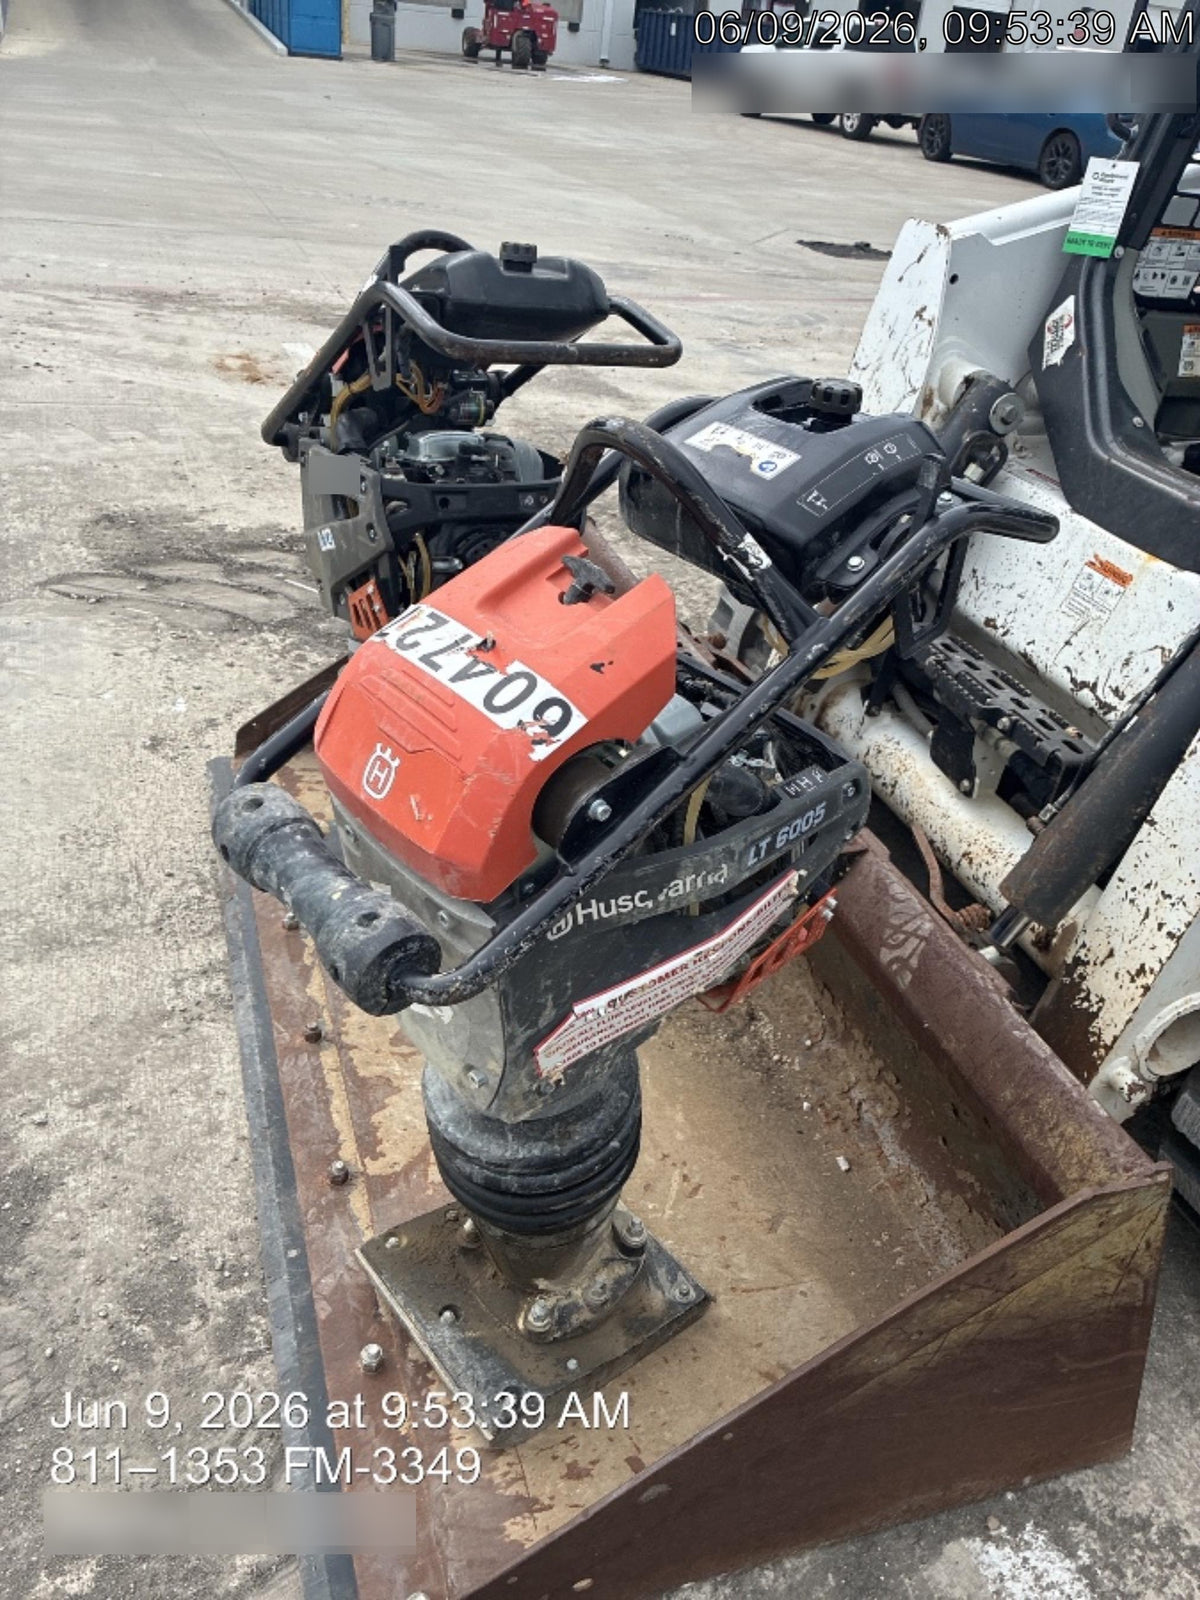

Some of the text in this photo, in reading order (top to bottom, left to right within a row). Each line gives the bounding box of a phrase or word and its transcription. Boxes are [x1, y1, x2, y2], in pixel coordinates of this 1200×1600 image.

[376, 605, 573, 745] 60472
[748, 802, 827, 867] LT 6005
